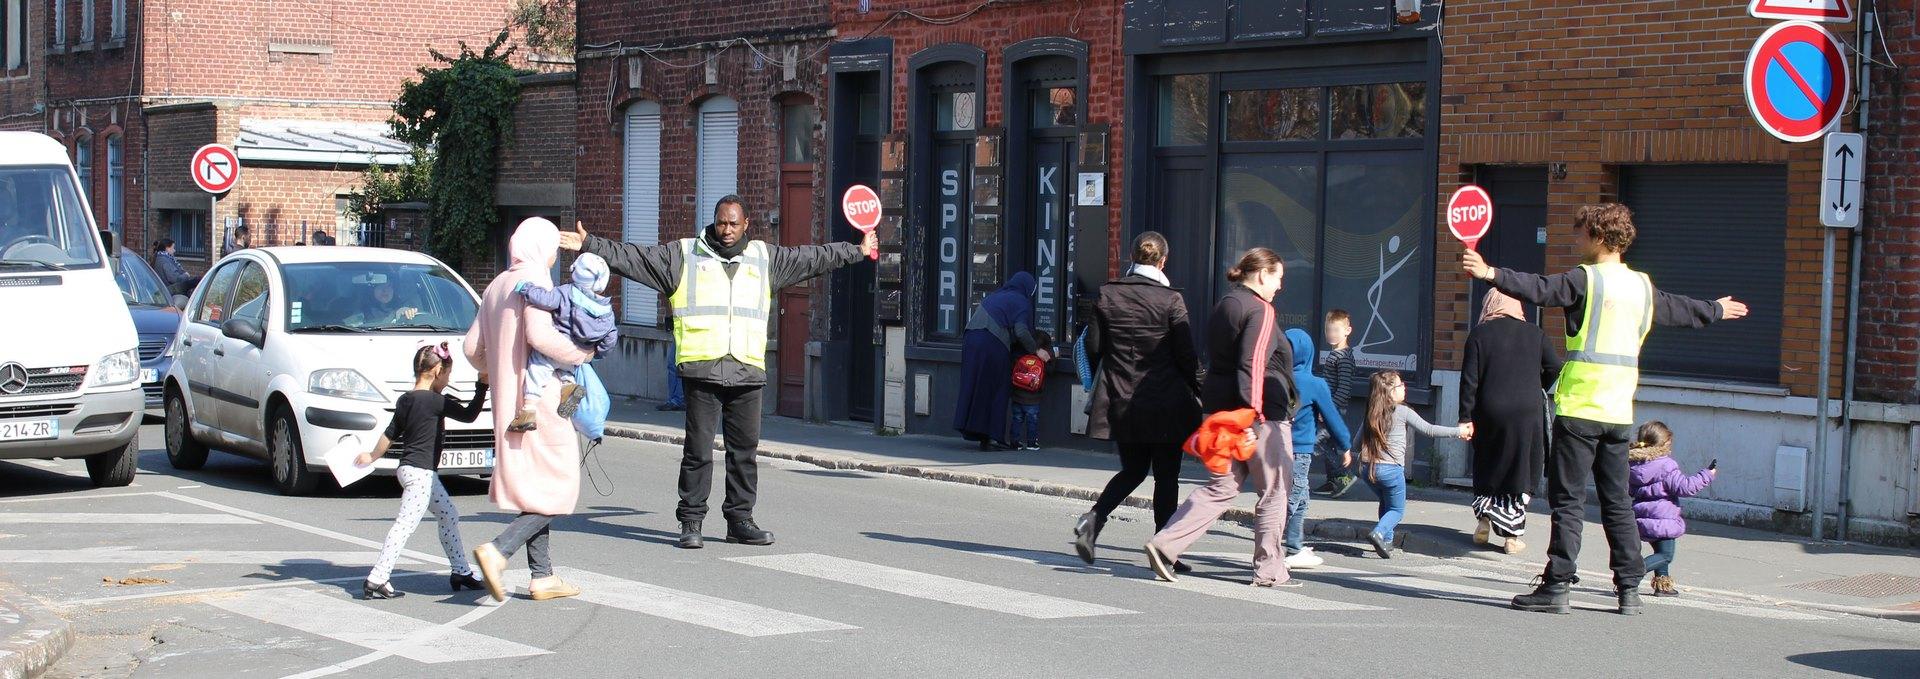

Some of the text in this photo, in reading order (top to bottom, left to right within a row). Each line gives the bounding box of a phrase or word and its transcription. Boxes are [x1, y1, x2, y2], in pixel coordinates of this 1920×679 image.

[848, 199, 877, 216] STOP
[1037, 166, 1057, 305] KINÉ
[1452, 204, 1487, 223] STOP
[939, 169, 959, 330] SPORT
